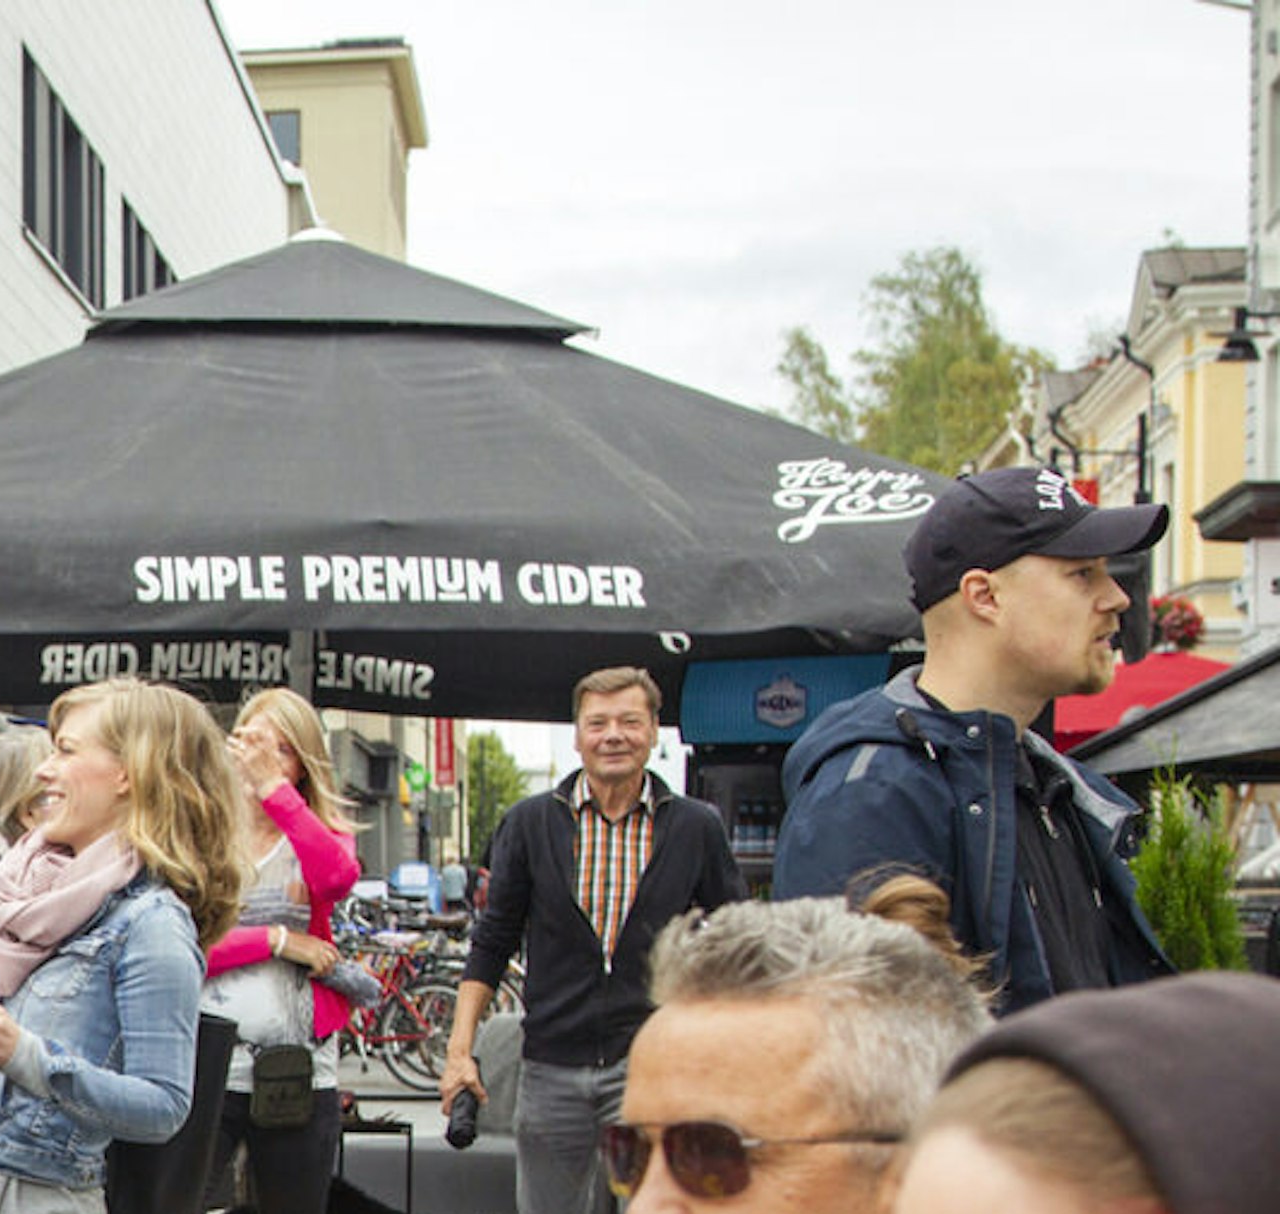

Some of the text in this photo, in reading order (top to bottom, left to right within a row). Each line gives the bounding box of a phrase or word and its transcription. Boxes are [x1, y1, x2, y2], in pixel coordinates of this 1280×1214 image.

[777, 457, 925, 493] Happy
[772, 485, 936, 543] Joe
[134, 555, 647, 607] SIMPLE PREMIUM CIDER
